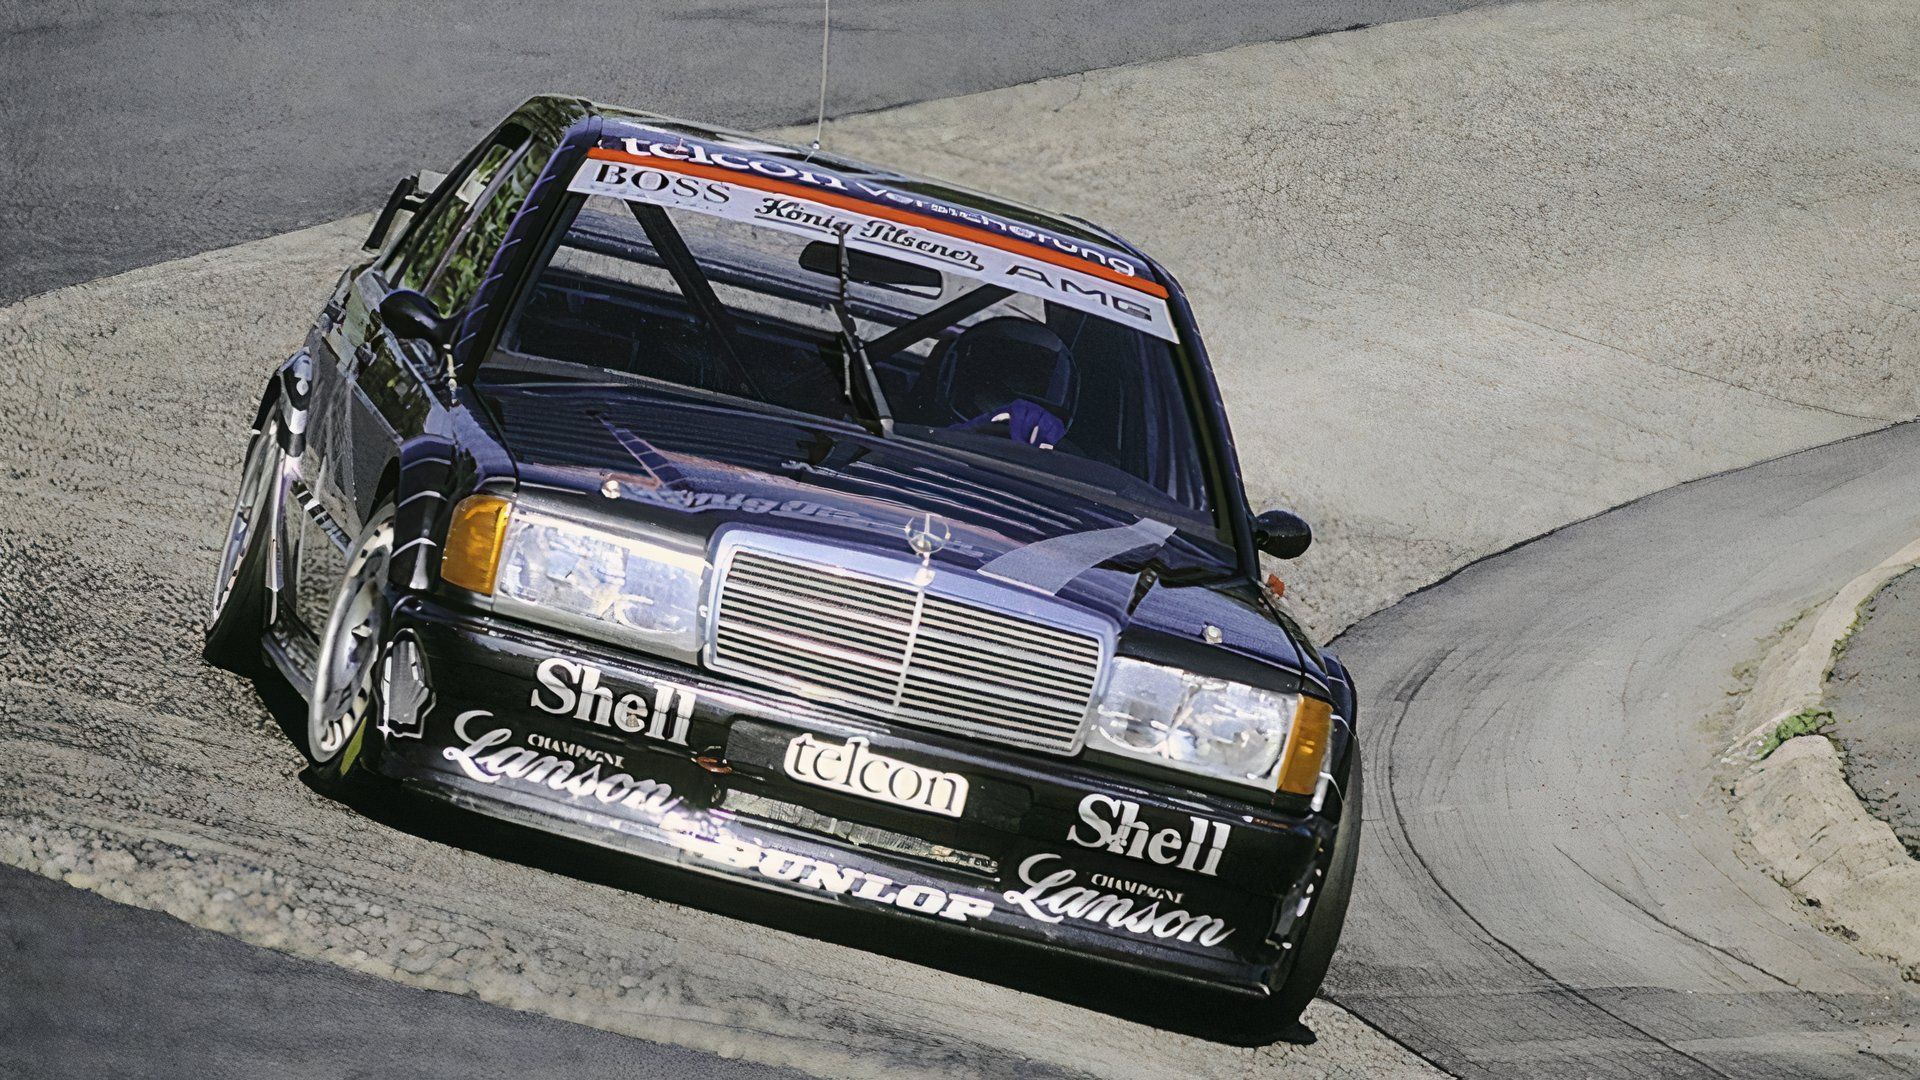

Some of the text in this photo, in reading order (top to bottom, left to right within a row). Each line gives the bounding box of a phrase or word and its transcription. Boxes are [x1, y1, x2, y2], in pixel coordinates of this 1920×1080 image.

[595, 164, 730, 204] BOSS
[620, 137, 848, 190] telcon
[754, 197, 984, 271] König Pilsener
[1005, 264, 1152, 322] AMG
[530, 658, 696, 746] Shell
[442, 709, 684, 815] Lanson
[793, 738, 958, 812] telcon
[1066, 793, 1232, 877] Shell
[1003, 853, 1236, 947] Lanson
